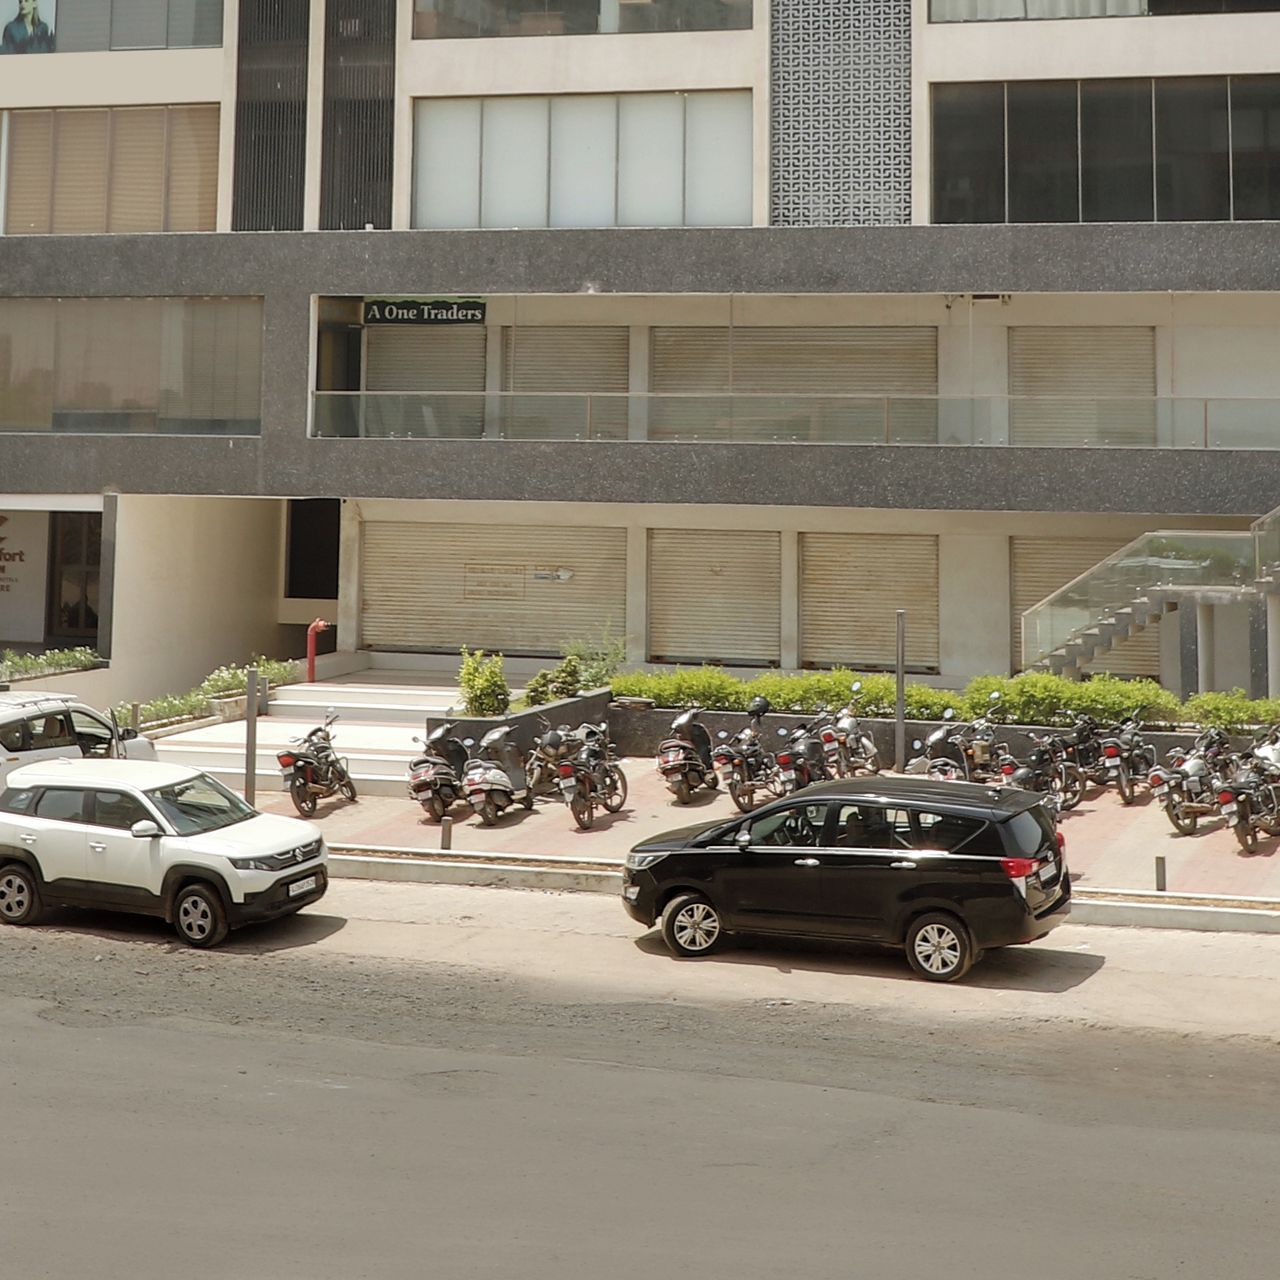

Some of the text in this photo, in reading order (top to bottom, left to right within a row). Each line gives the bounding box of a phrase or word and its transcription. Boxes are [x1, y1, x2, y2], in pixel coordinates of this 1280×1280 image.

[368, 305, 483, 320] A One Traders
